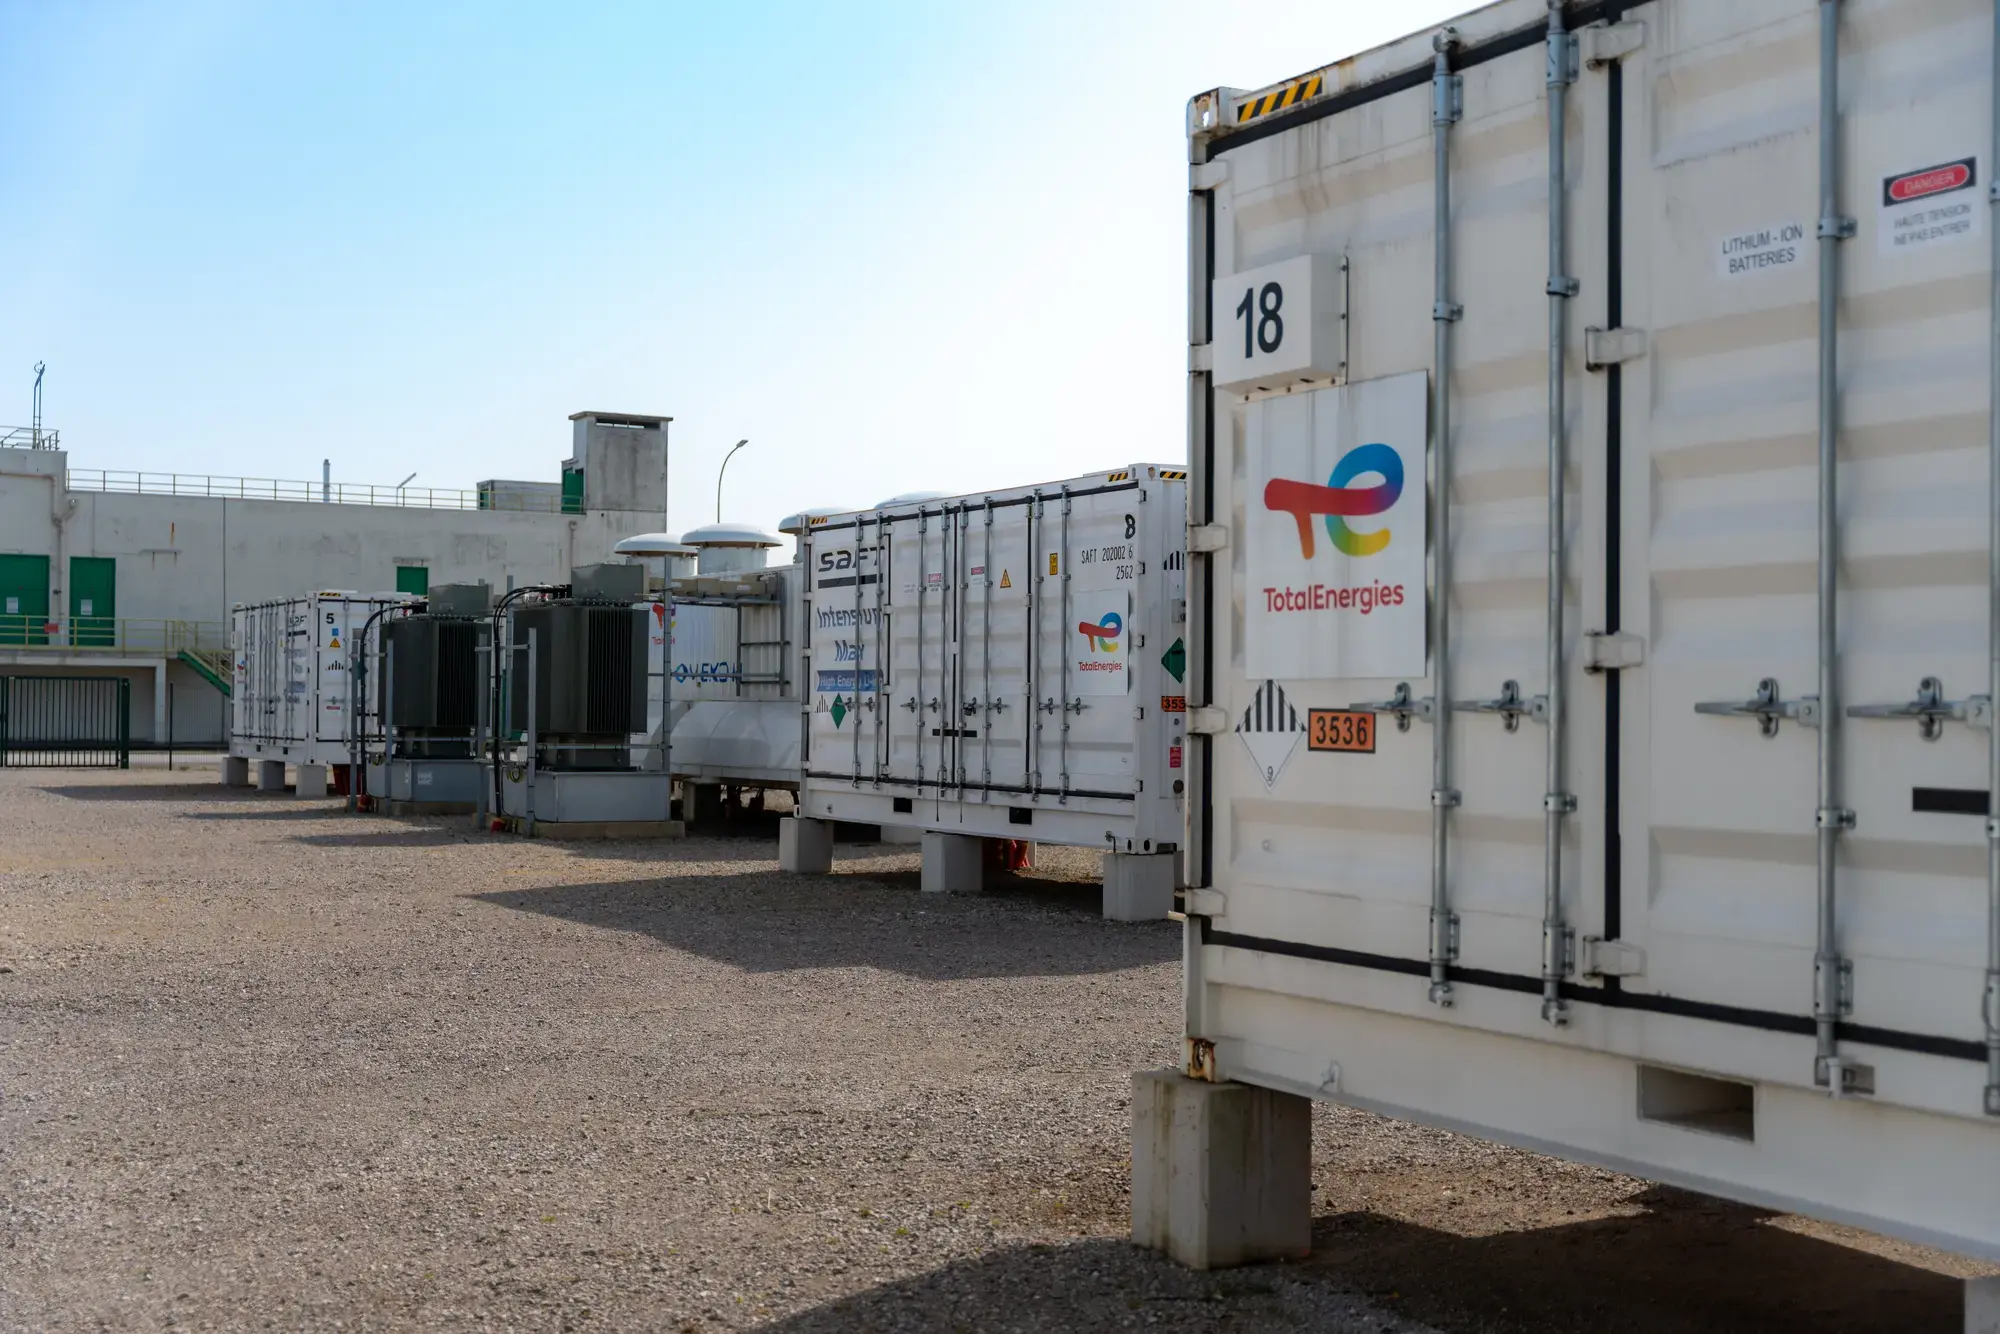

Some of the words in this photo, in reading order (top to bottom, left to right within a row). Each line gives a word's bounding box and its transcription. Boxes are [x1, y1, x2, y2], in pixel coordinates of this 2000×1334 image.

[1722, 230, 1770, 255] LITHIUM
[1781, 223, 1803, 242] ION
[1729, 246, 1796, 274] BATTERIES
[1236, 281, 1284, 359] 18
[1124, 513, 1136, 540] 8
[1081, 549, 1097, 564] SAFT
[1102, 545, 1126, 562] 202002
[1116, 565, 1133, 580] 25G2
[1263, 578, 1405, 615] TotalEnergies
[326, 612, 335, 625] 5
[1078, 660, 1122, 673] TotalEnergies
[1315, 715, 1368, 746] 3536
